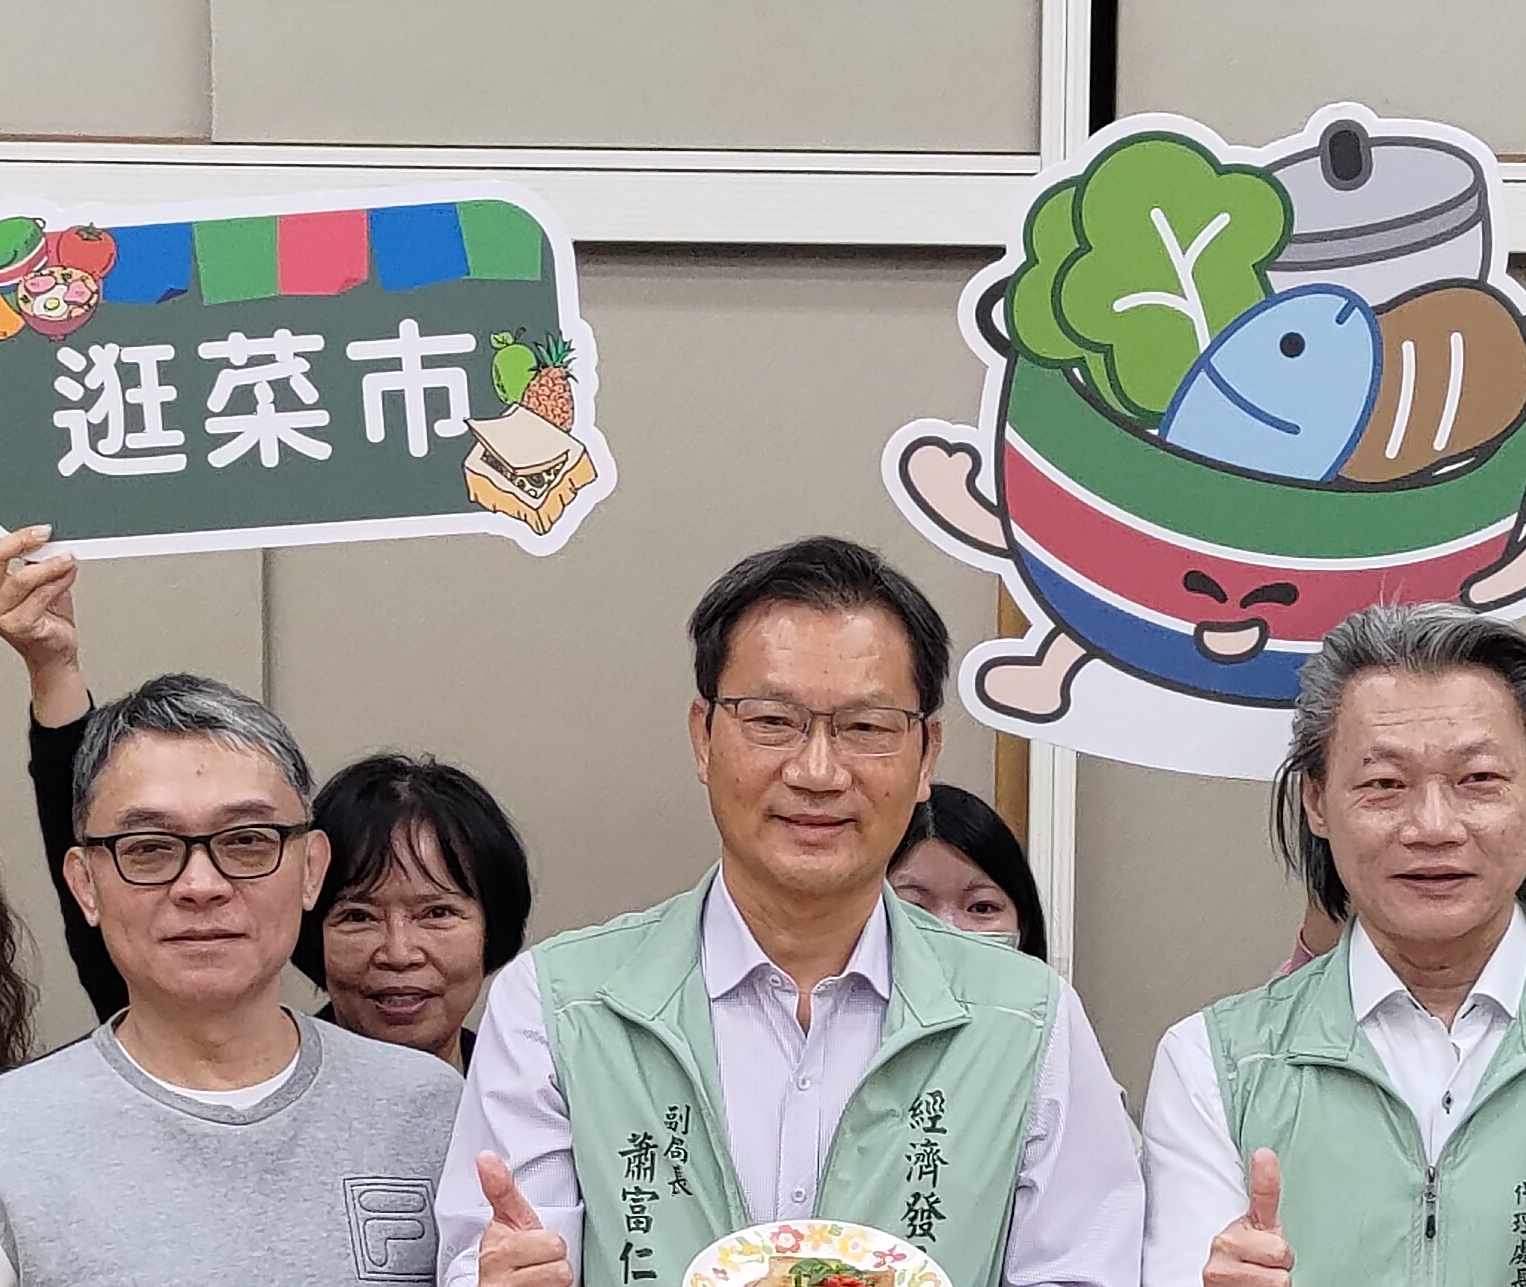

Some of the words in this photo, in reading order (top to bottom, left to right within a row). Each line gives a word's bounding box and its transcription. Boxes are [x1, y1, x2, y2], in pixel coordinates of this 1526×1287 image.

[52, 318, 476, 477] 逛菜市
[618, 1131, 661, 1286] 蕭富仁
[663, 1103, 693, 1198] 副局長
[901, 1090, 949, 1254] 經濟發
